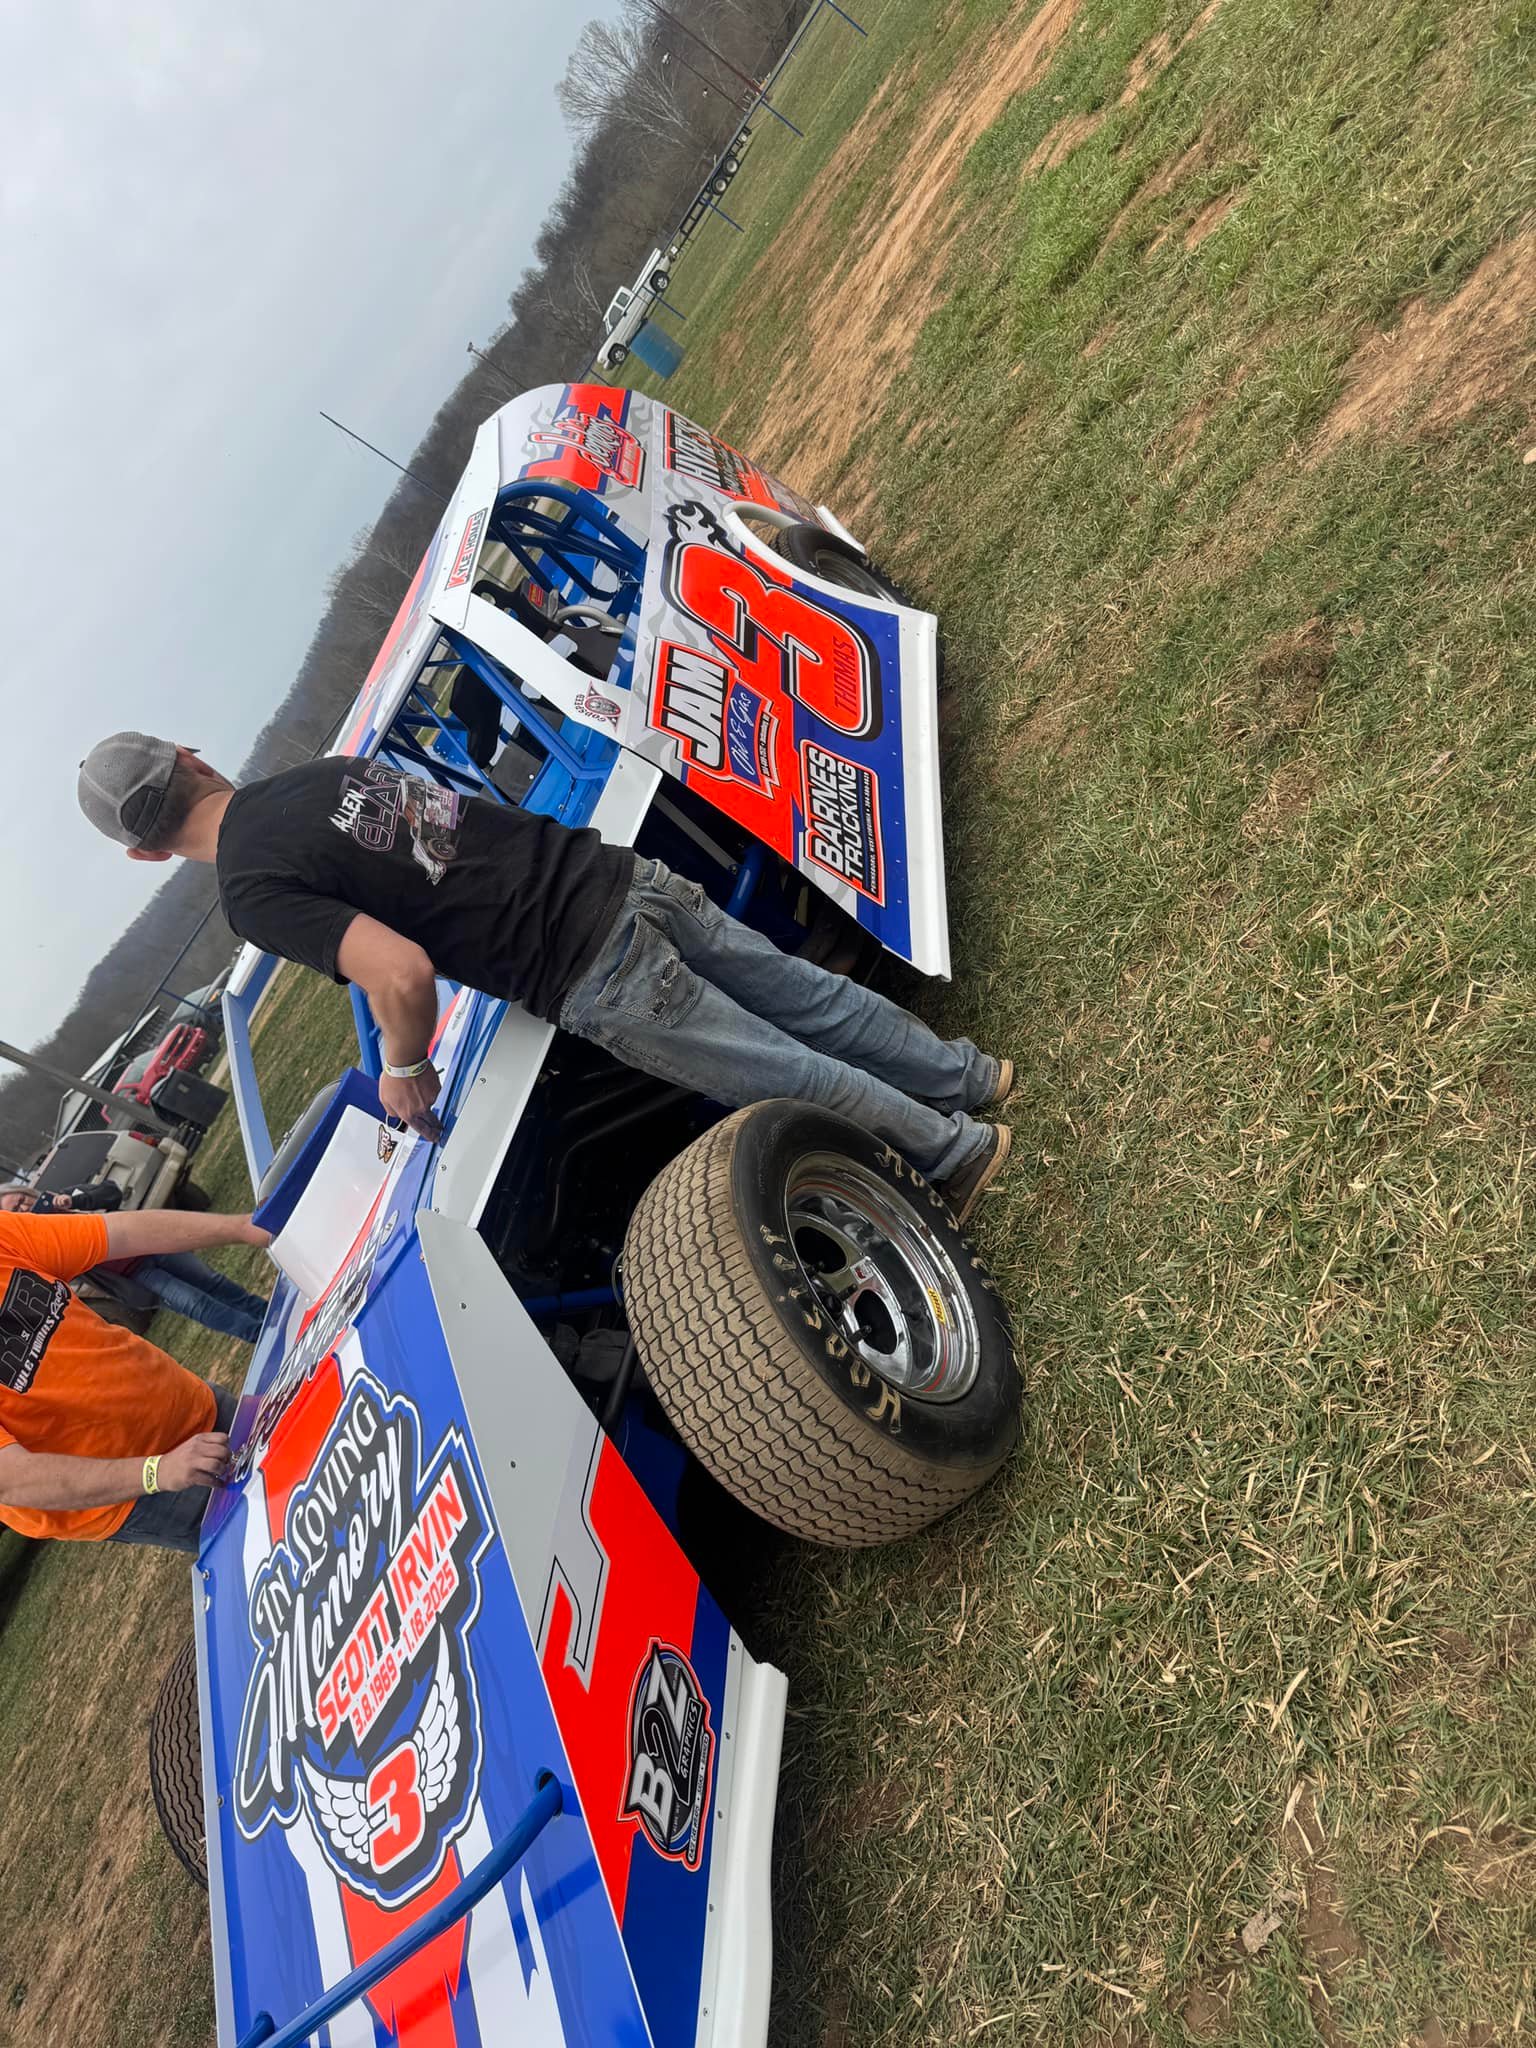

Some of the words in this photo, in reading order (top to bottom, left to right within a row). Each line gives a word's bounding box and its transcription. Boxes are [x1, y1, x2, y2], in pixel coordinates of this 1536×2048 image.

[678, 544, 867, 732] 3
[832, 636, 858, 718] THOMAS
[666, 648, 724, 767] JAM
[729, 732, 755, 776] Oil
[730, 692, 755, 727] Gas
[329, 787, 368, 833] ALLEN
[808, 747, 844, 874] BARNES
[837, 761, 865, 881] TRUCKING
[13, 1360, 34, 1392] KYLE
[255, 1566, 292, 1656] IN
[291, 1395, 378, 1588] LOVING
[240, 1418, 403, 1808] Memory
[316, 1588, 393, 1742] SCOTT
[390, 1472, 468, 1613] IRVIN
[354, 1657, 398, 1739] 3.8.1969
[403, 1564, 457, 1647] 1.18.2025
[627, 1650, 691, 1850] B2Z
[680, 1704, 699, 1779] GRAPHICS
[369, 1745, 423, 1868] 3
